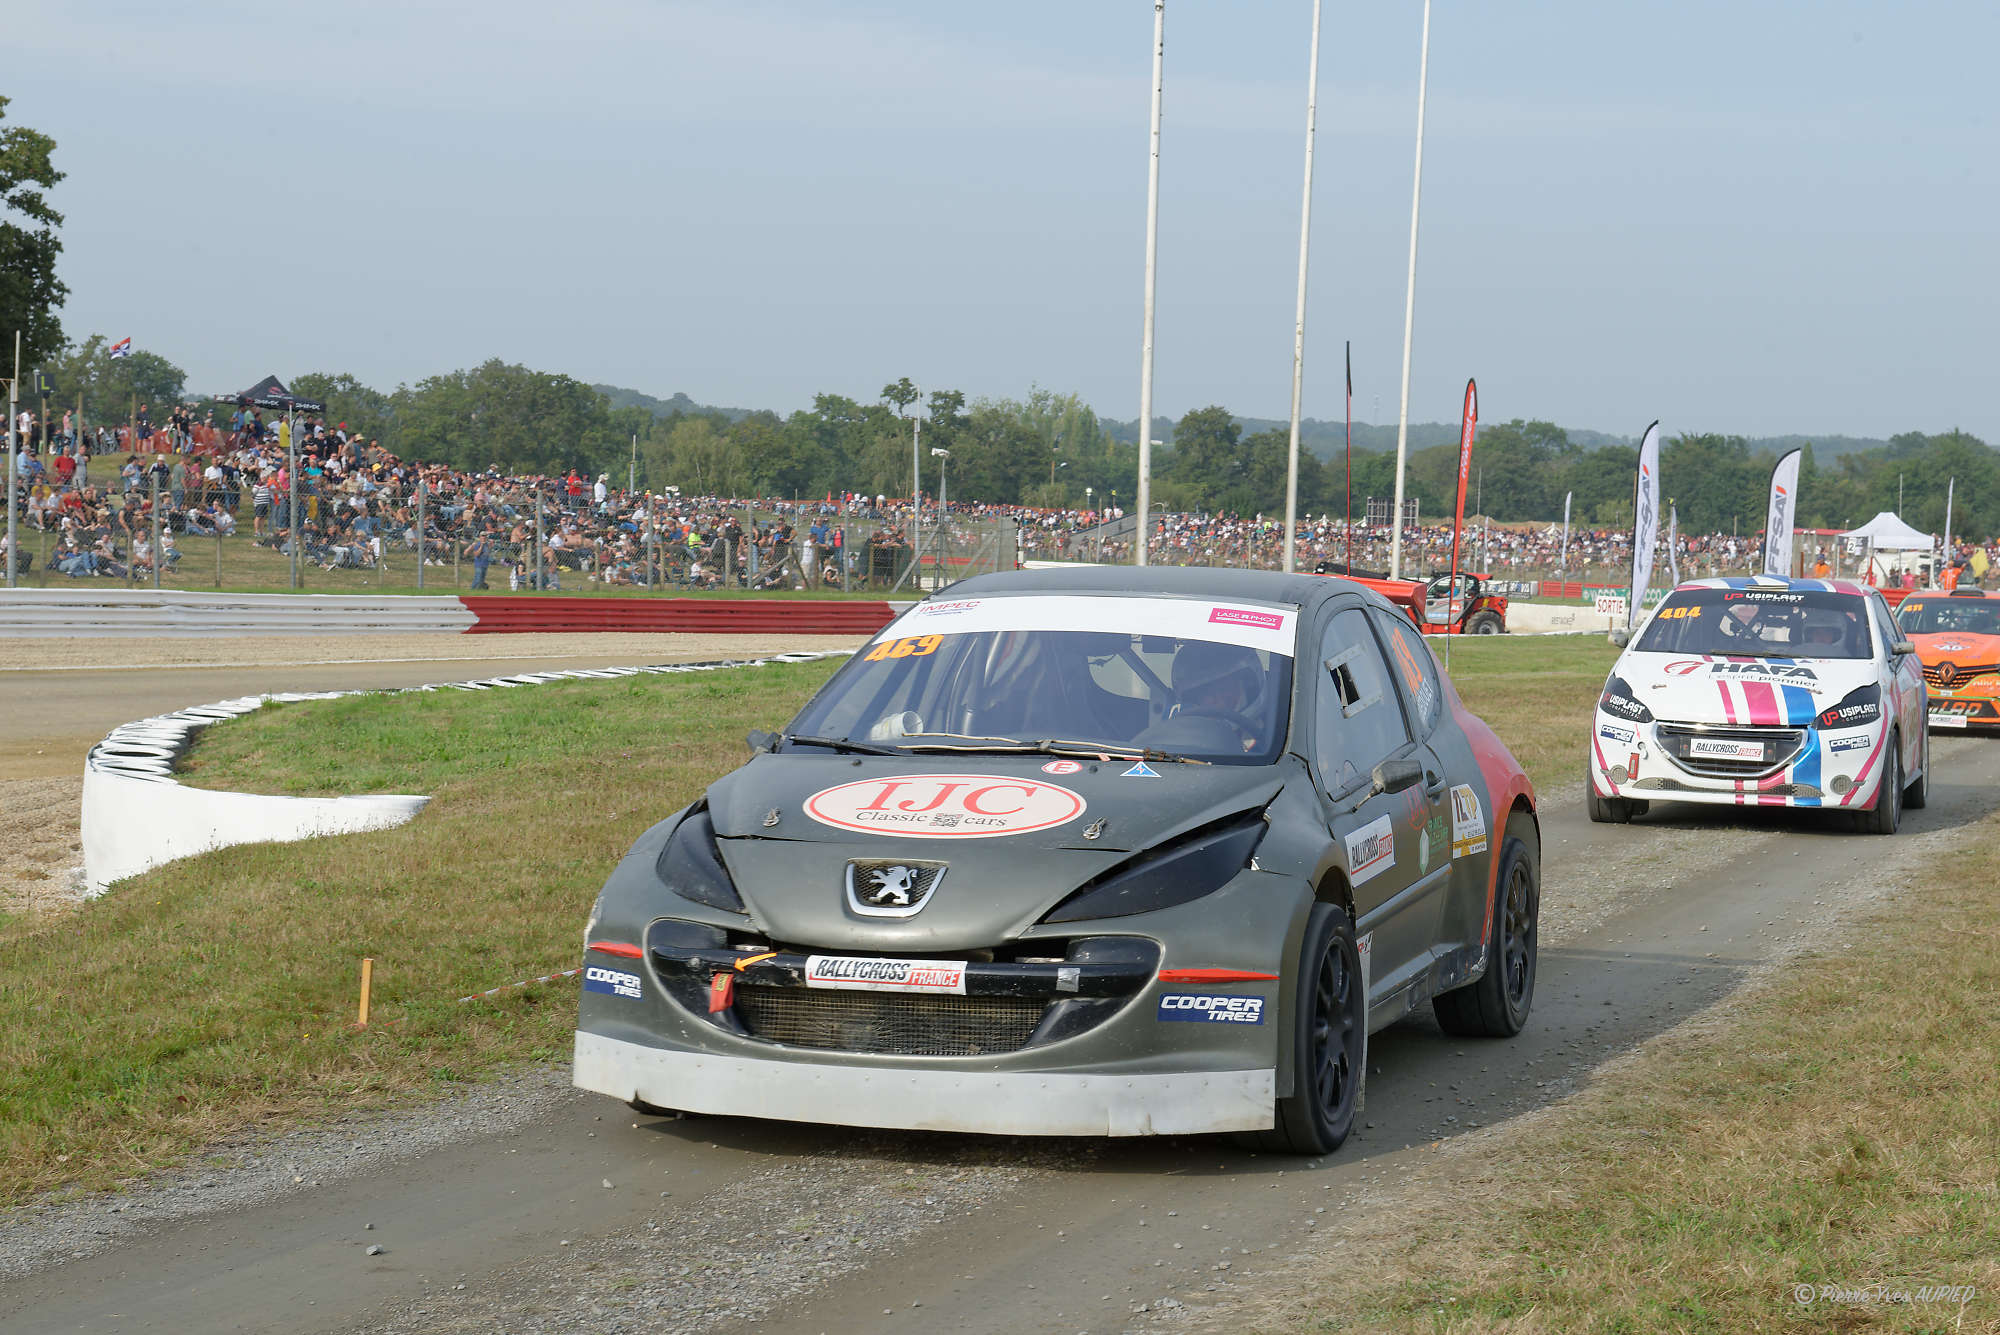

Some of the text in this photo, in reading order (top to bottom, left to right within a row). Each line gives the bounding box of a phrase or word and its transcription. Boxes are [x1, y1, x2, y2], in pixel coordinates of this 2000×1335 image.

[41, 375, 49, 390] L
[1745, 592, 1805, 602] USIPLAST
[1597, 599, 1623, 614] SORTIE
[1658, 606, 1702, 620] 404
[863, 633, 945, 662] 469
[1711, 663, 1819, 681] HAFA
[1609, 694, 1647, 715] USIPLAST
[1839, 703, 1878, 719] USIPLAST
[1602, 726, 1634, 738] COOPER
[1696, 742, 1739, 754] RALLYCROSS
[1830, 736, 1869, 747] COOPER
[1055, 762, 1075, 774] E
[855, 781, 1037, 815] IJC
[855, 810, 1008, 828] Classic cars
[1351, 833, 1379, 870] RALLYCROSS
[586, 967, 642, 989] COOPER
[815, 958, 958, 987] RALLYCROSS FRANCE
[613, 984, 642, 999] TIRES
[1160, 995, 1263, 1012] COOPER
[1207, 1010, 1260, 1022] TIRES
